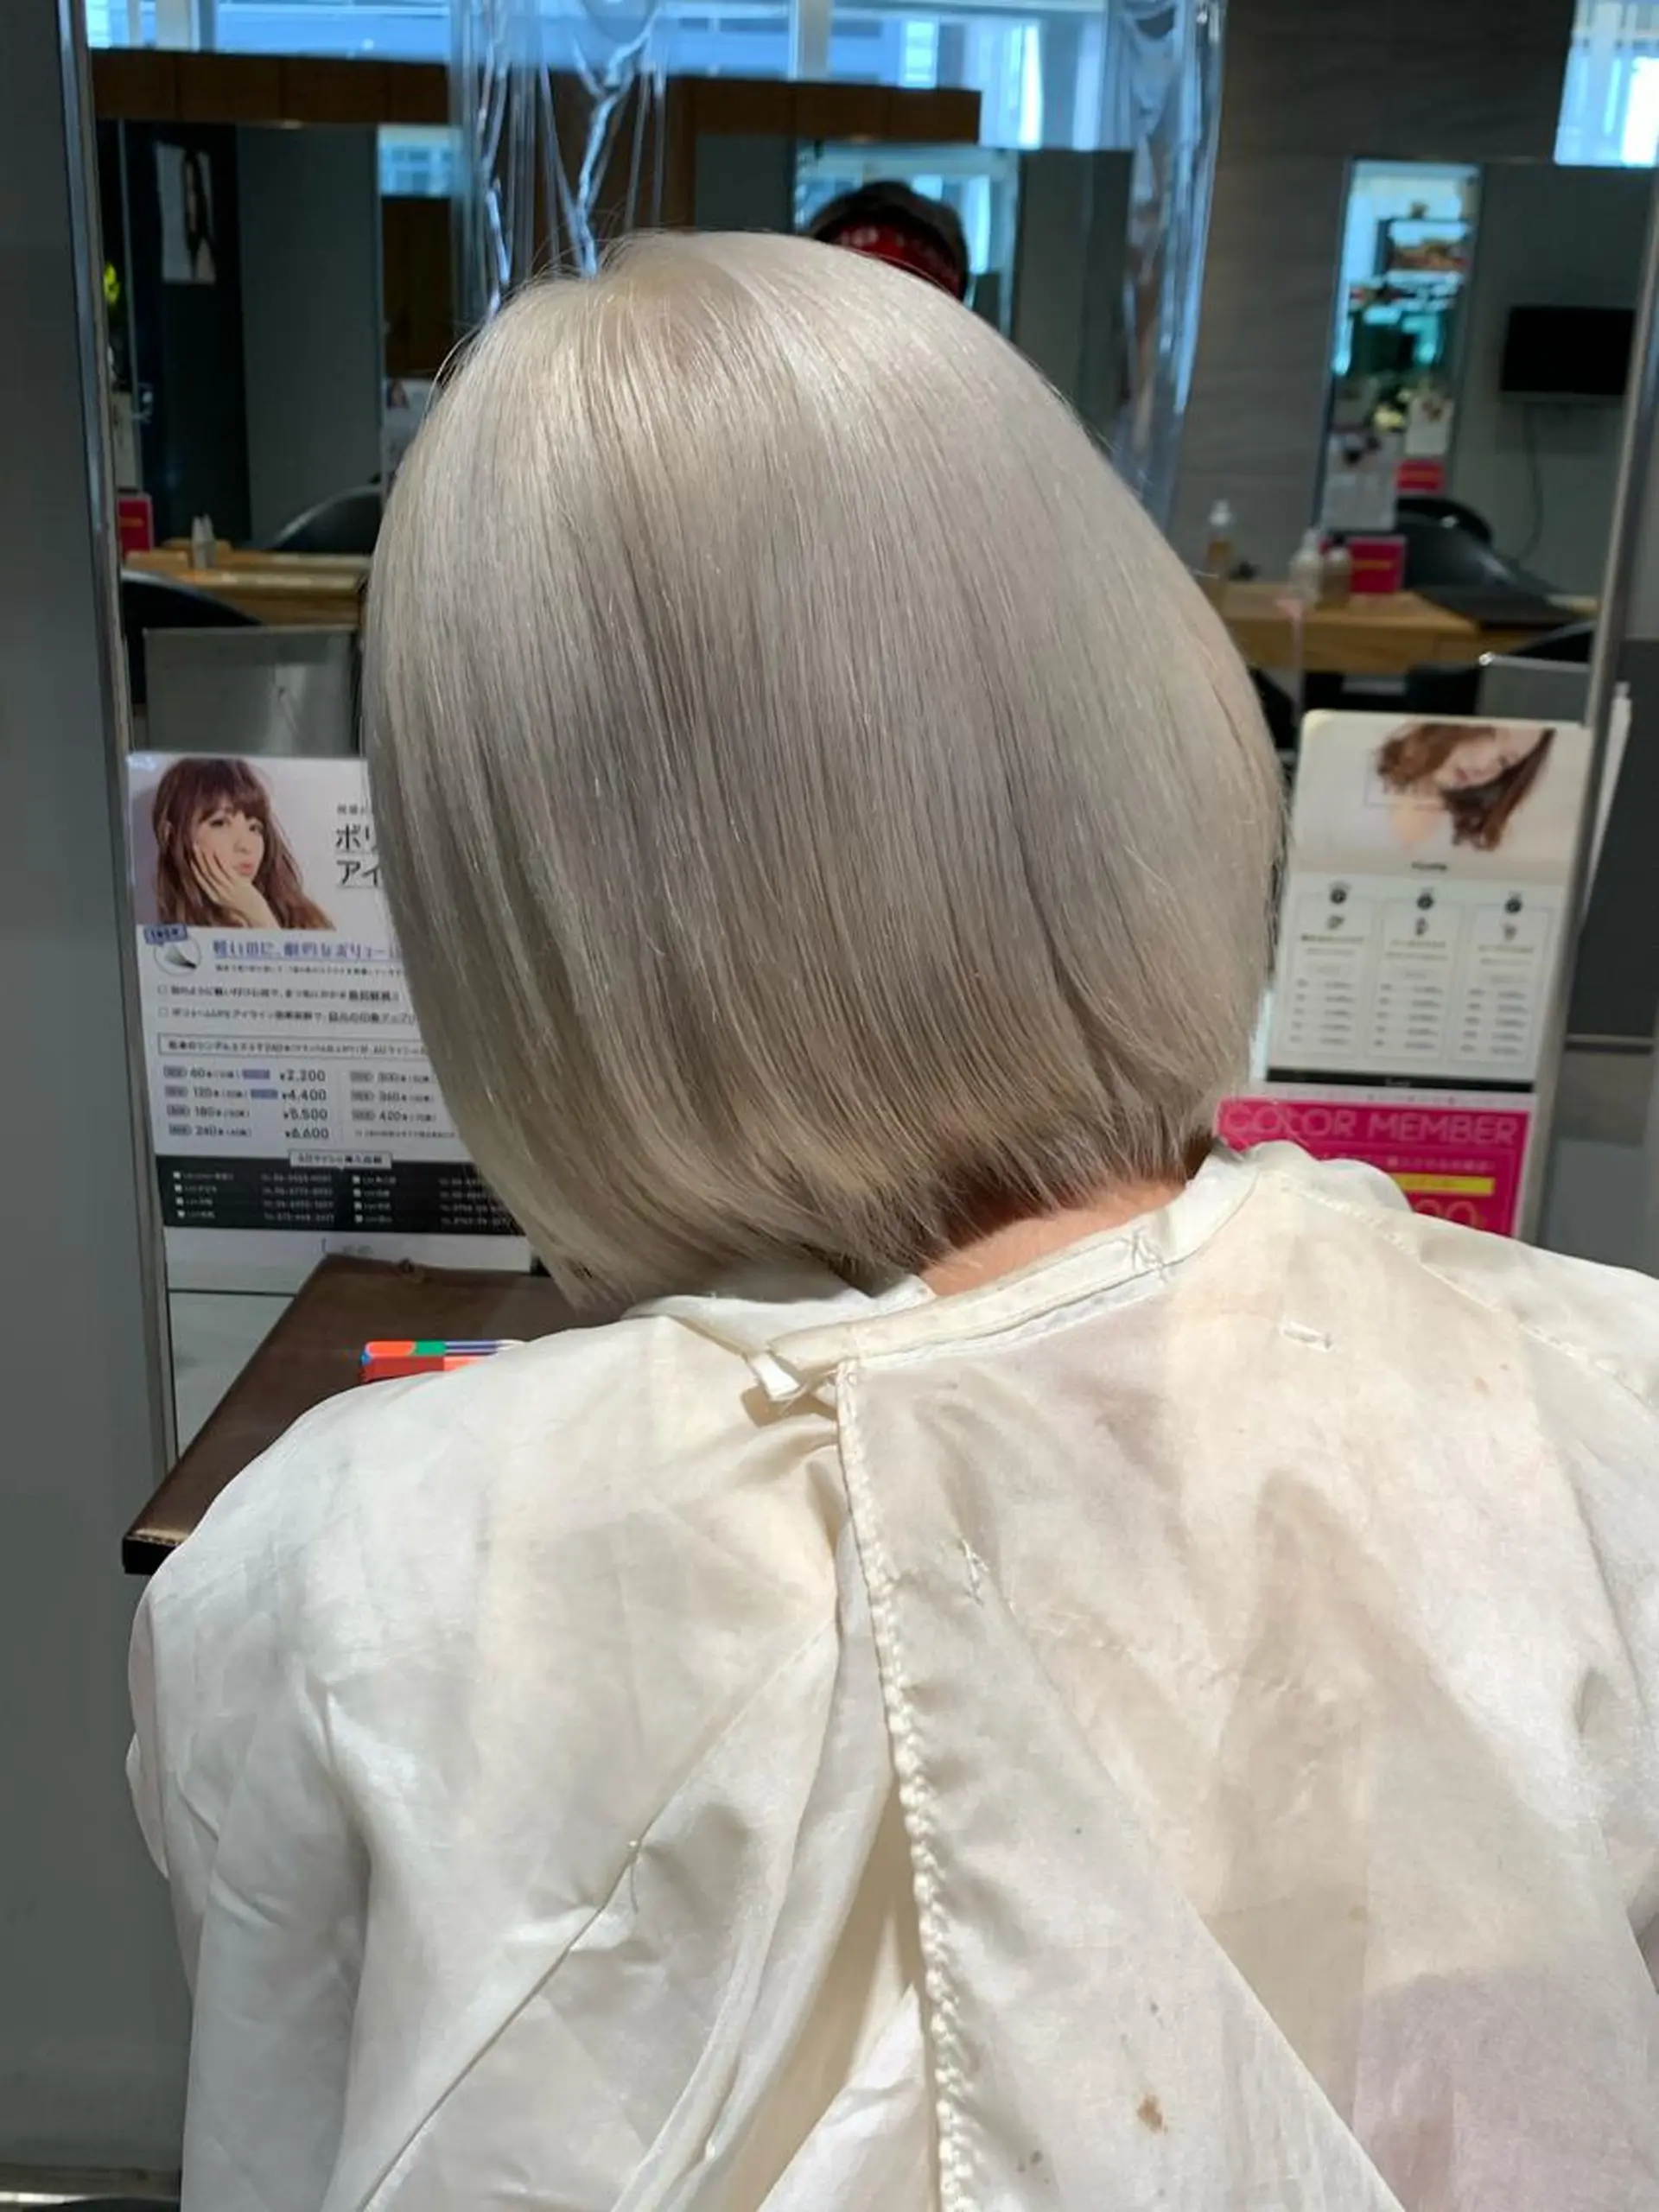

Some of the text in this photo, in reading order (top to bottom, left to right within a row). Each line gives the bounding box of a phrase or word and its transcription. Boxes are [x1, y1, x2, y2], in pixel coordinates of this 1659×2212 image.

[280, 1070, 326, 1082] ¥2,200
[282, 1089, 327, 1102] ¥4,400
[1223, 1103, 1520, 1146] COLOR MEMBER
[285, 1127, 329, 1139] ¥6,600
